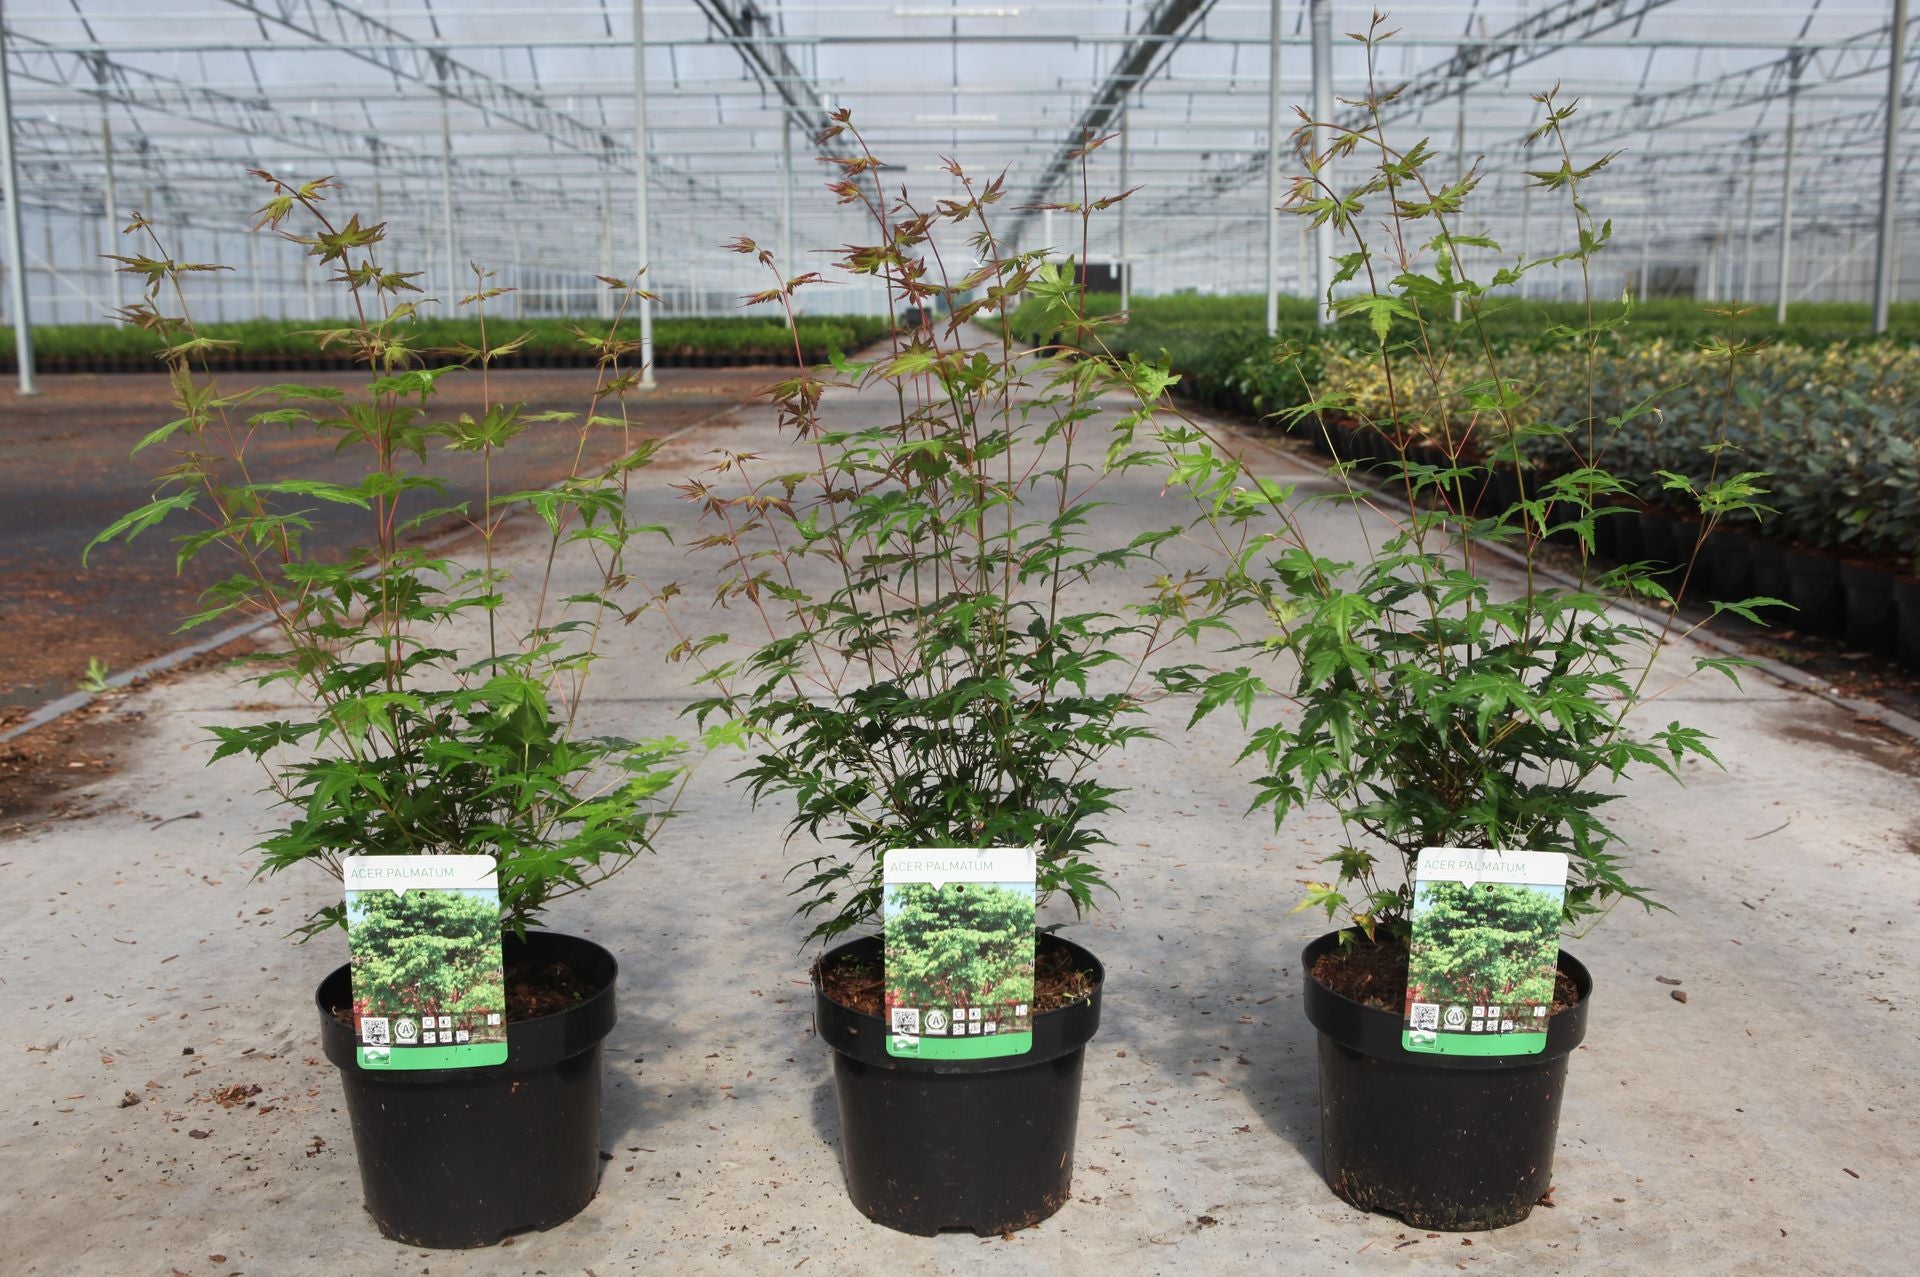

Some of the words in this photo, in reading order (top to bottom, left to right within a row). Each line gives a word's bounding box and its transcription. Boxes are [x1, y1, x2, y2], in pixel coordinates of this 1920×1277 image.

[890, 861, 922, 872] ACER
[926, 861, 993, 872] PALMATUM
[1424, 860, 1455, 870] ACER
[1459, 861, 1525, 873] PALMATUM
[351, 868, 383, 879] ACER
[386, 867, 455, 878] PALMATUM
